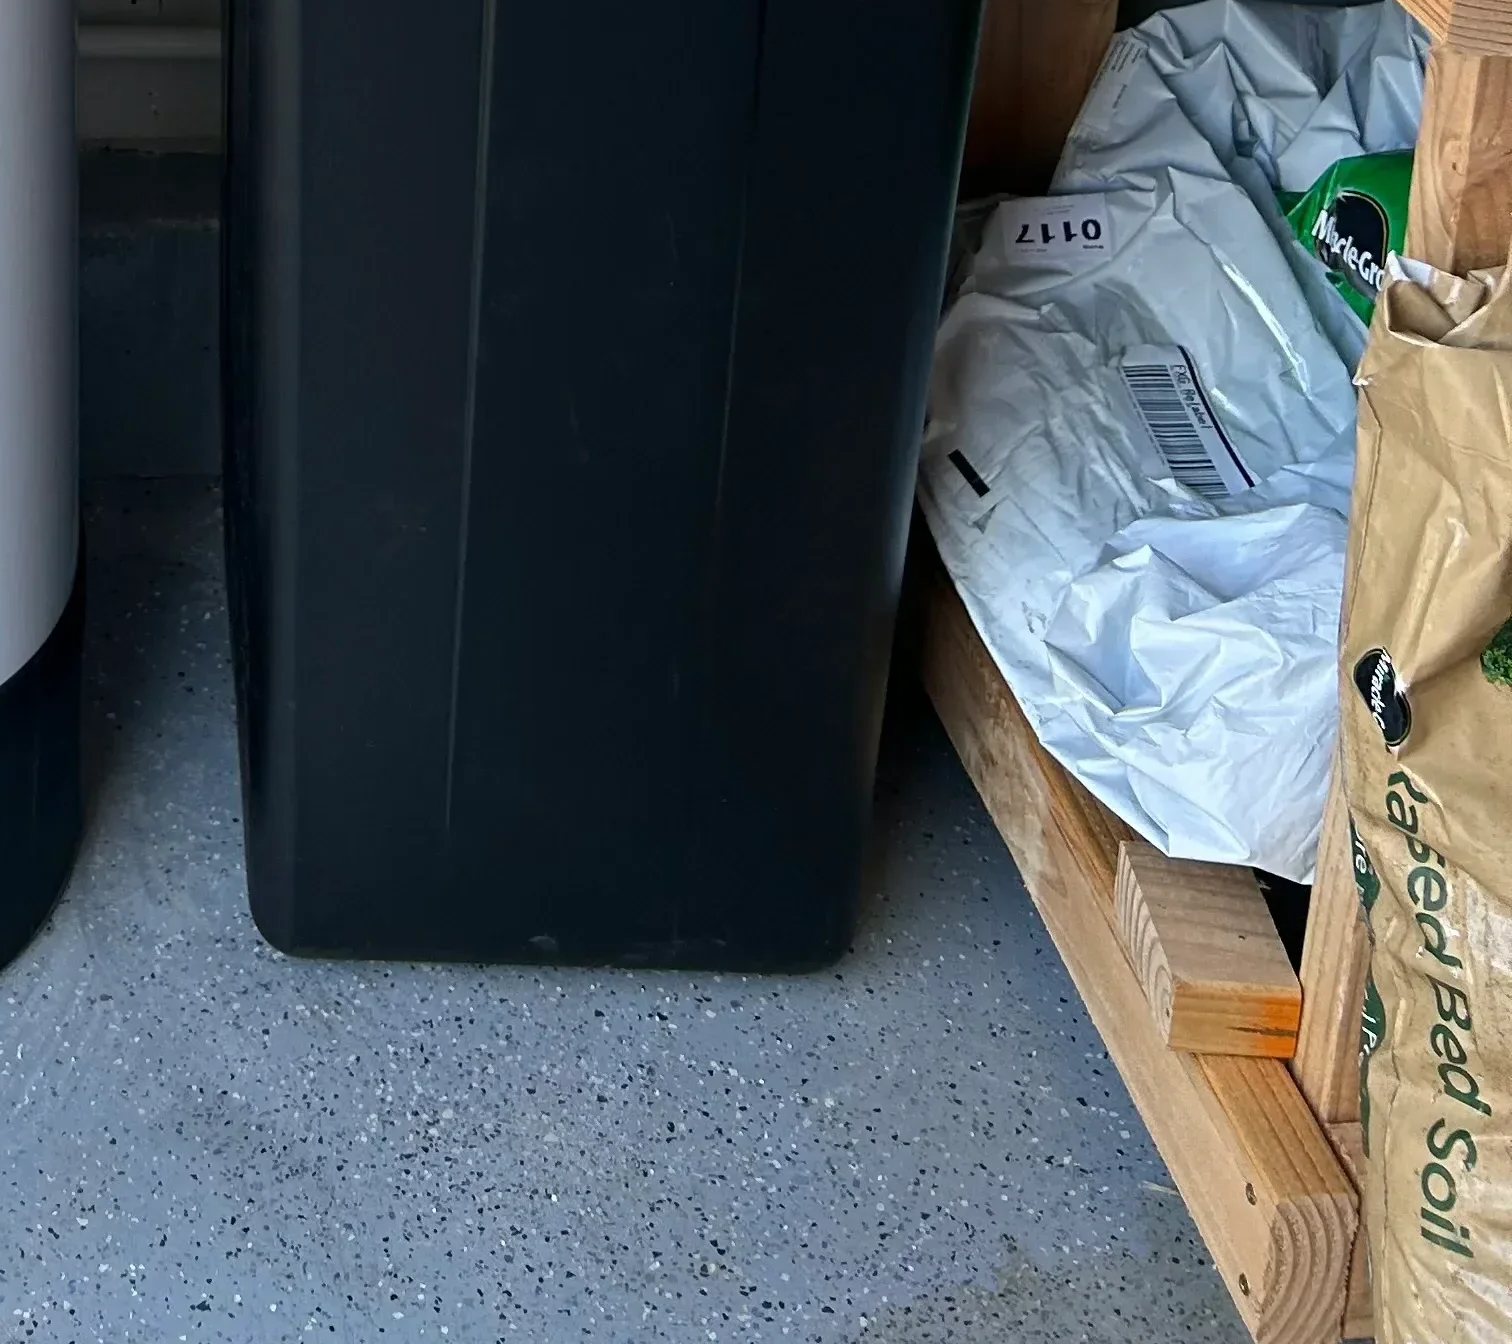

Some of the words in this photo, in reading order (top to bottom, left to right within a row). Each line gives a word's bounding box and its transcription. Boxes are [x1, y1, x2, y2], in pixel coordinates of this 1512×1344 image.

[1014, 218, 1102, 244] 0117
[1424, 972, 1492, 1117] Bed
[1420, 1117, 1478, 1259] Soil
